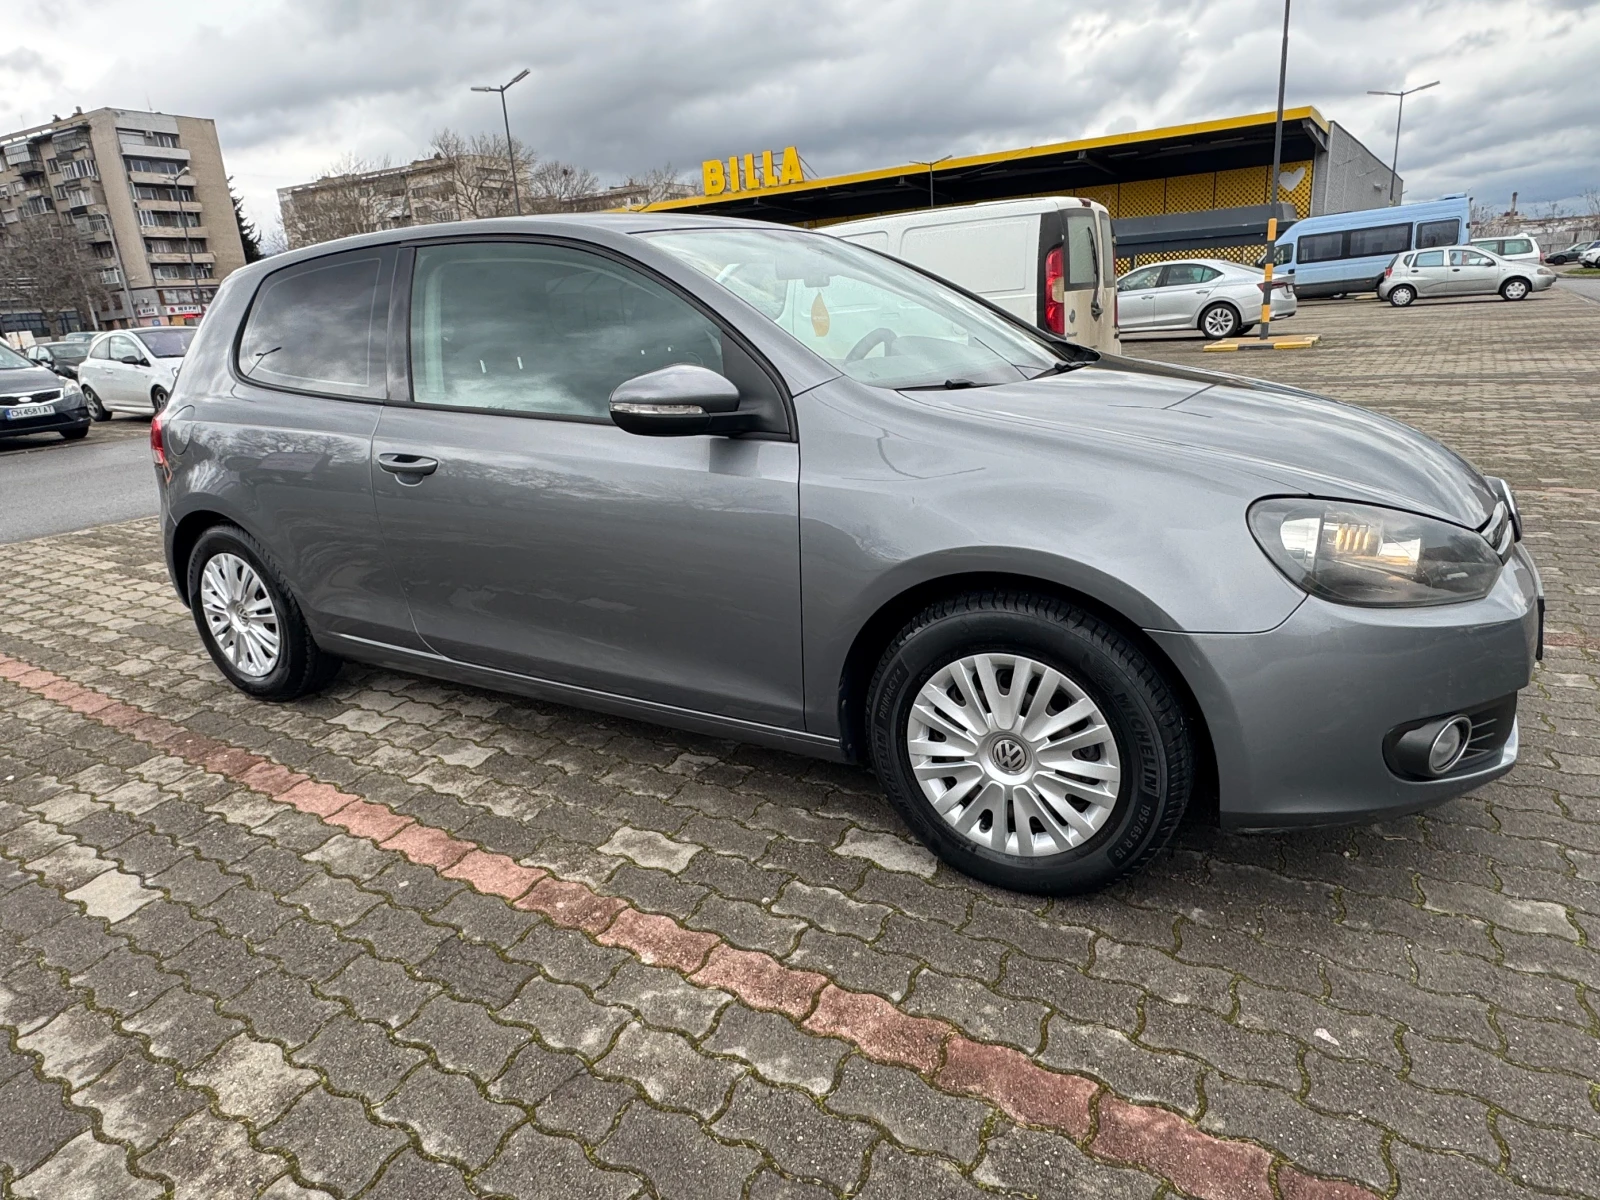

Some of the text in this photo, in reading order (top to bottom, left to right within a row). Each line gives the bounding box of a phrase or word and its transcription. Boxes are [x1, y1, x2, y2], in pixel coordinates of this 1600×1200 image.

[702, 146, 804, 196] BILLA
[11, 405, 53, 417] CH 4581 AT
[878, 673, 899, 720] PRIMACY
[1115, 692, 1158, 793] MICHELIN
[876, 729, 910, 811] MICHELIN
[1114, 804, 1152, 860] 195/65 R 15
